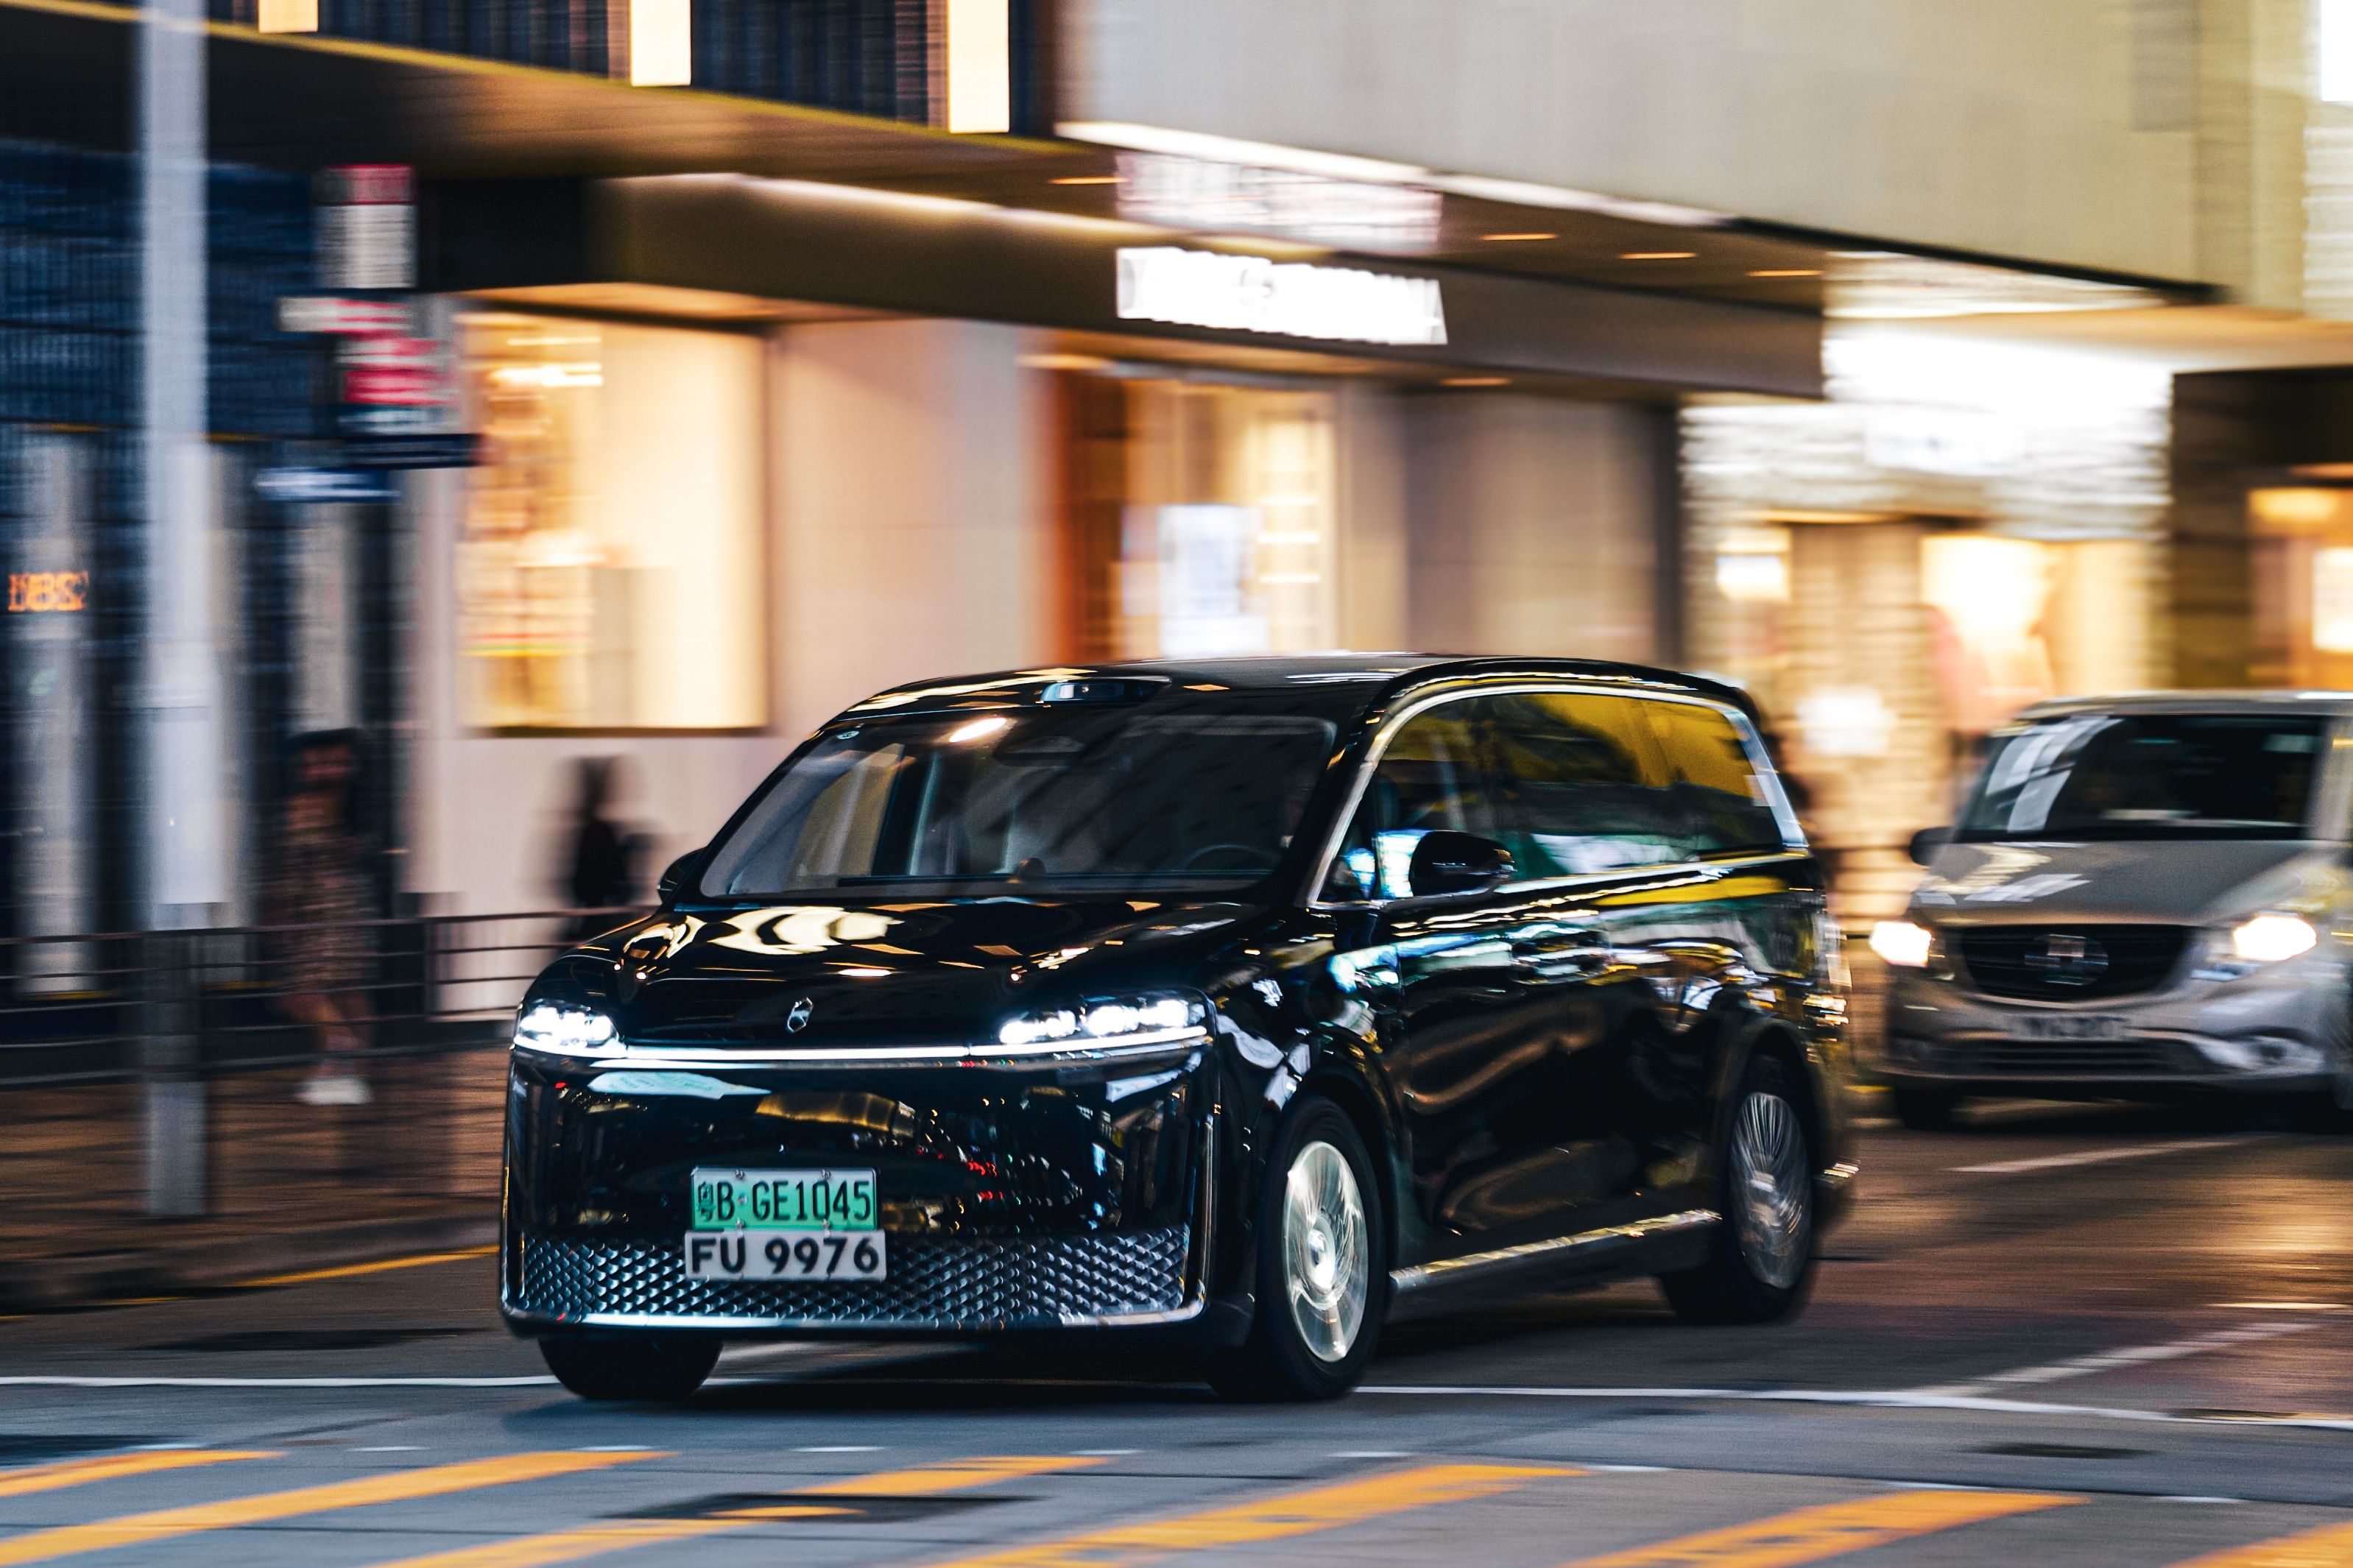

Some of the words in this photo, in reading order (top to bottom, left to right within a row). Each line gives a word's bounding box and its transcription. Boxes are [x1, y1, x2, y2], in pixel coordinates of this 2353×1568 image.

[752, 1180, 871, 1221] GE1045
[691, 1237, 746, 1274] FU
[764, 1237, 879, 1274] 9976
